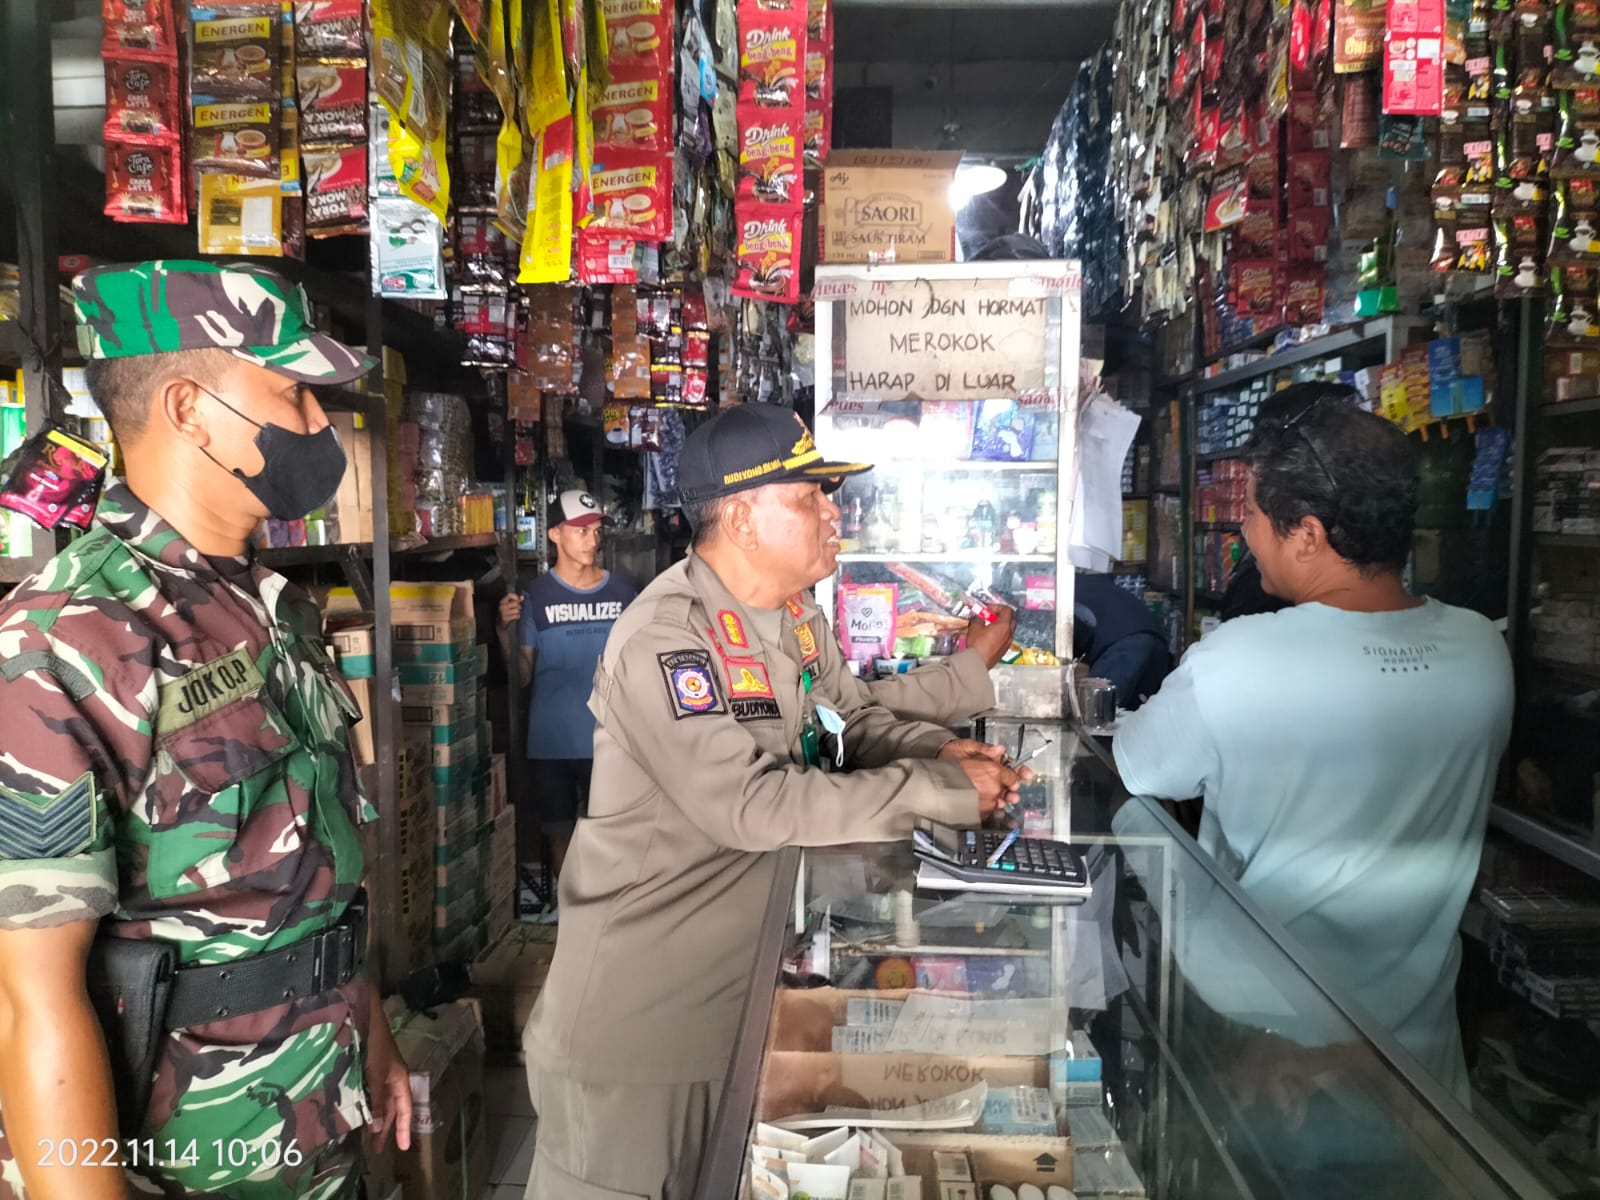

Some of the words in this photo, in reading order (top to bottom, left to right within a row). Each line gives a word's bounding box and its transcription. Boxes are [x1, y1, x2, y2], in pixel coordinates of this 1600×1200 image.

[201, 23, 265, 37] ENERGEN
[746, 26, 790, 49] Drink
[200, 108, 265, 121] ENERGEN
[745, 123, 789, 146] Drink
[127, 153, 150, 167] Tora
[593, 172, 651, 189] ENERGEN
[309, 191, 346, 204] MOKA
[313, 204, 347, 217] TORA
[862, 206, 915, 221] SAORI
[743, 218, 787, 240] Drink
[851, 231, 883, 244] SAUS
[887, 232, 926, 245] TIRAM
[850, 299, 912, 316] MOHON
[979, 298, 1046, 316] HORMAT
[890, 332, 996, 353] MEROKOK
[850, 371, 914, 392] HARAP
[936, 374, 950, 392] DI
[963, 372, 1016, 393] LUAR
